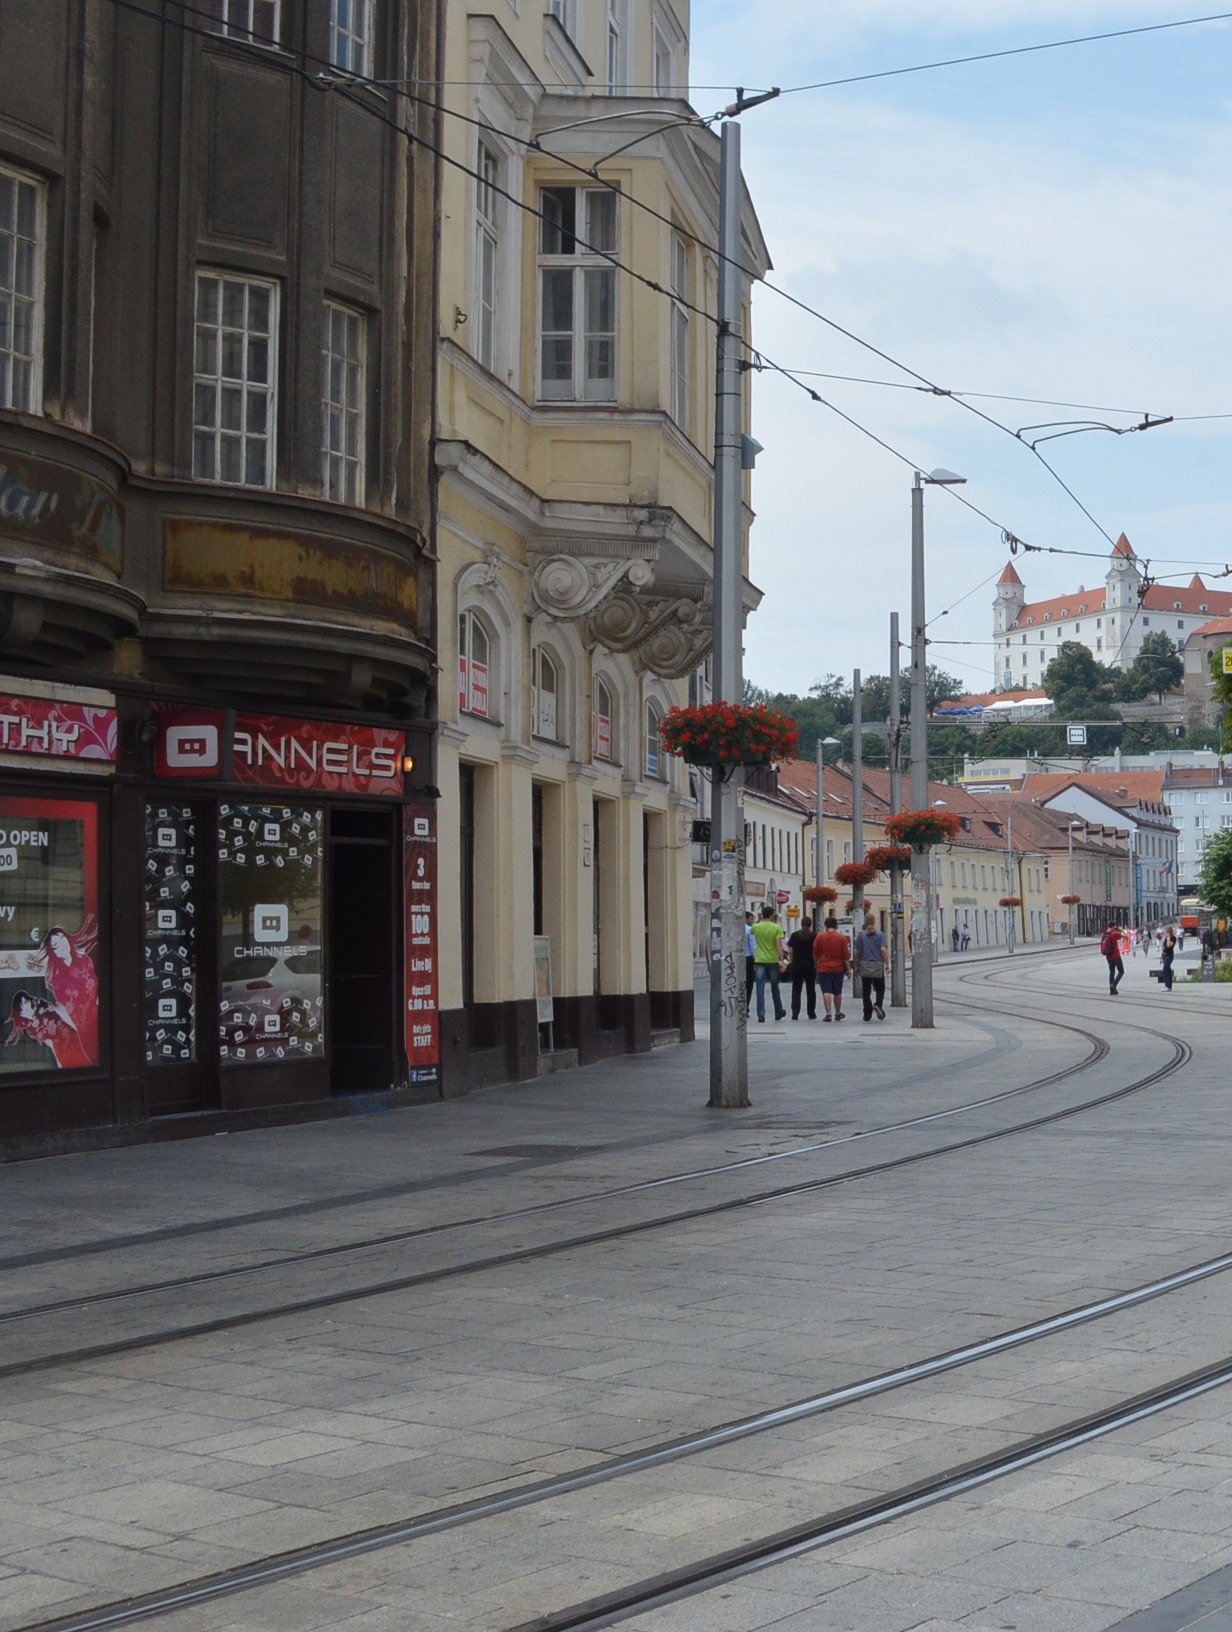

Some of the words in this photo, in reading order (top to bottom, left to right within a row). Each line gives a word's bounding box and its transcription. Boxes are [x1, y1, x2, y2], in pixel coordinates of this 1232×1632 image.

[10, 830, 48, 846] OPEN
[147, 847, 186, 855] CHANNELS
[417, 857, 425, 877] 3
[411, 914, 430, 935] 100
[233, 945, 308, 958] CHANNELS
[413, 1034, 432, 1047] STAFF
